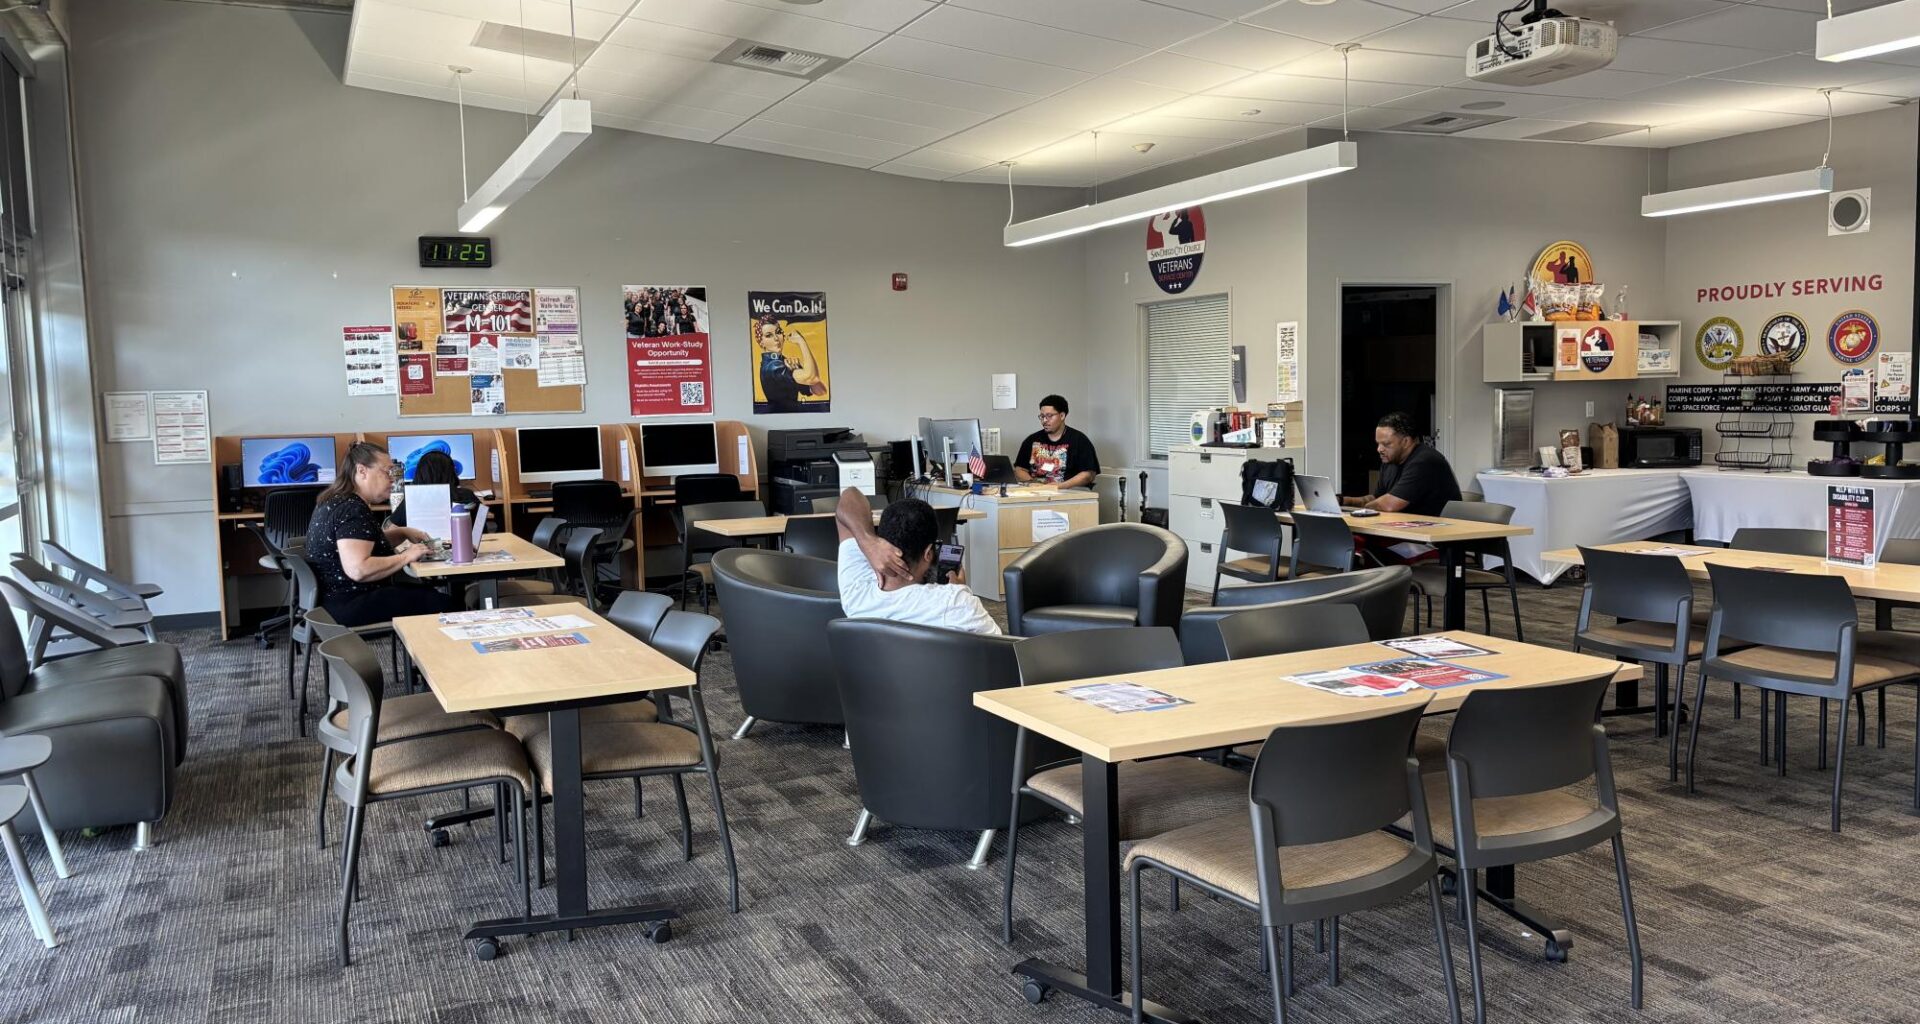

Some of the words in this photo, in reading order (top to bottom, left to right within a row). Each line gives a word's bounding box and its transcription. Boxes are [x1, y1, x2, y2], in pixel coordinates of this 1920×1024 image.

[1158, 258, 1193, 273] VETERANS
[1697, 281, 1786, 303] PROUDLY
[1791, 274, 1883, 296] SERVING
[447, 292, 490, 301] VETERANS
[492, 292, 526, 301] SERVICE
[471, 303, 504, 312] CENER
[752, 299, 771, 313] We
[772, 299, 793, 313] Can
[794, 299, 810, 313] Do
[465, 314, 511, 332] M-101
[661, 341, 703, 349] Work-Study
[647, 349, 689, 357] Opportunity
[1585, 356, 1610, 364] VETERANS
[1790, 404, 1811, 412] COAST
[1875, 404, 1900, 412] CORPS
[1832, 493, 1855, 502] DISABILITY
[1856, 495, 1869, 503] CLAIM
